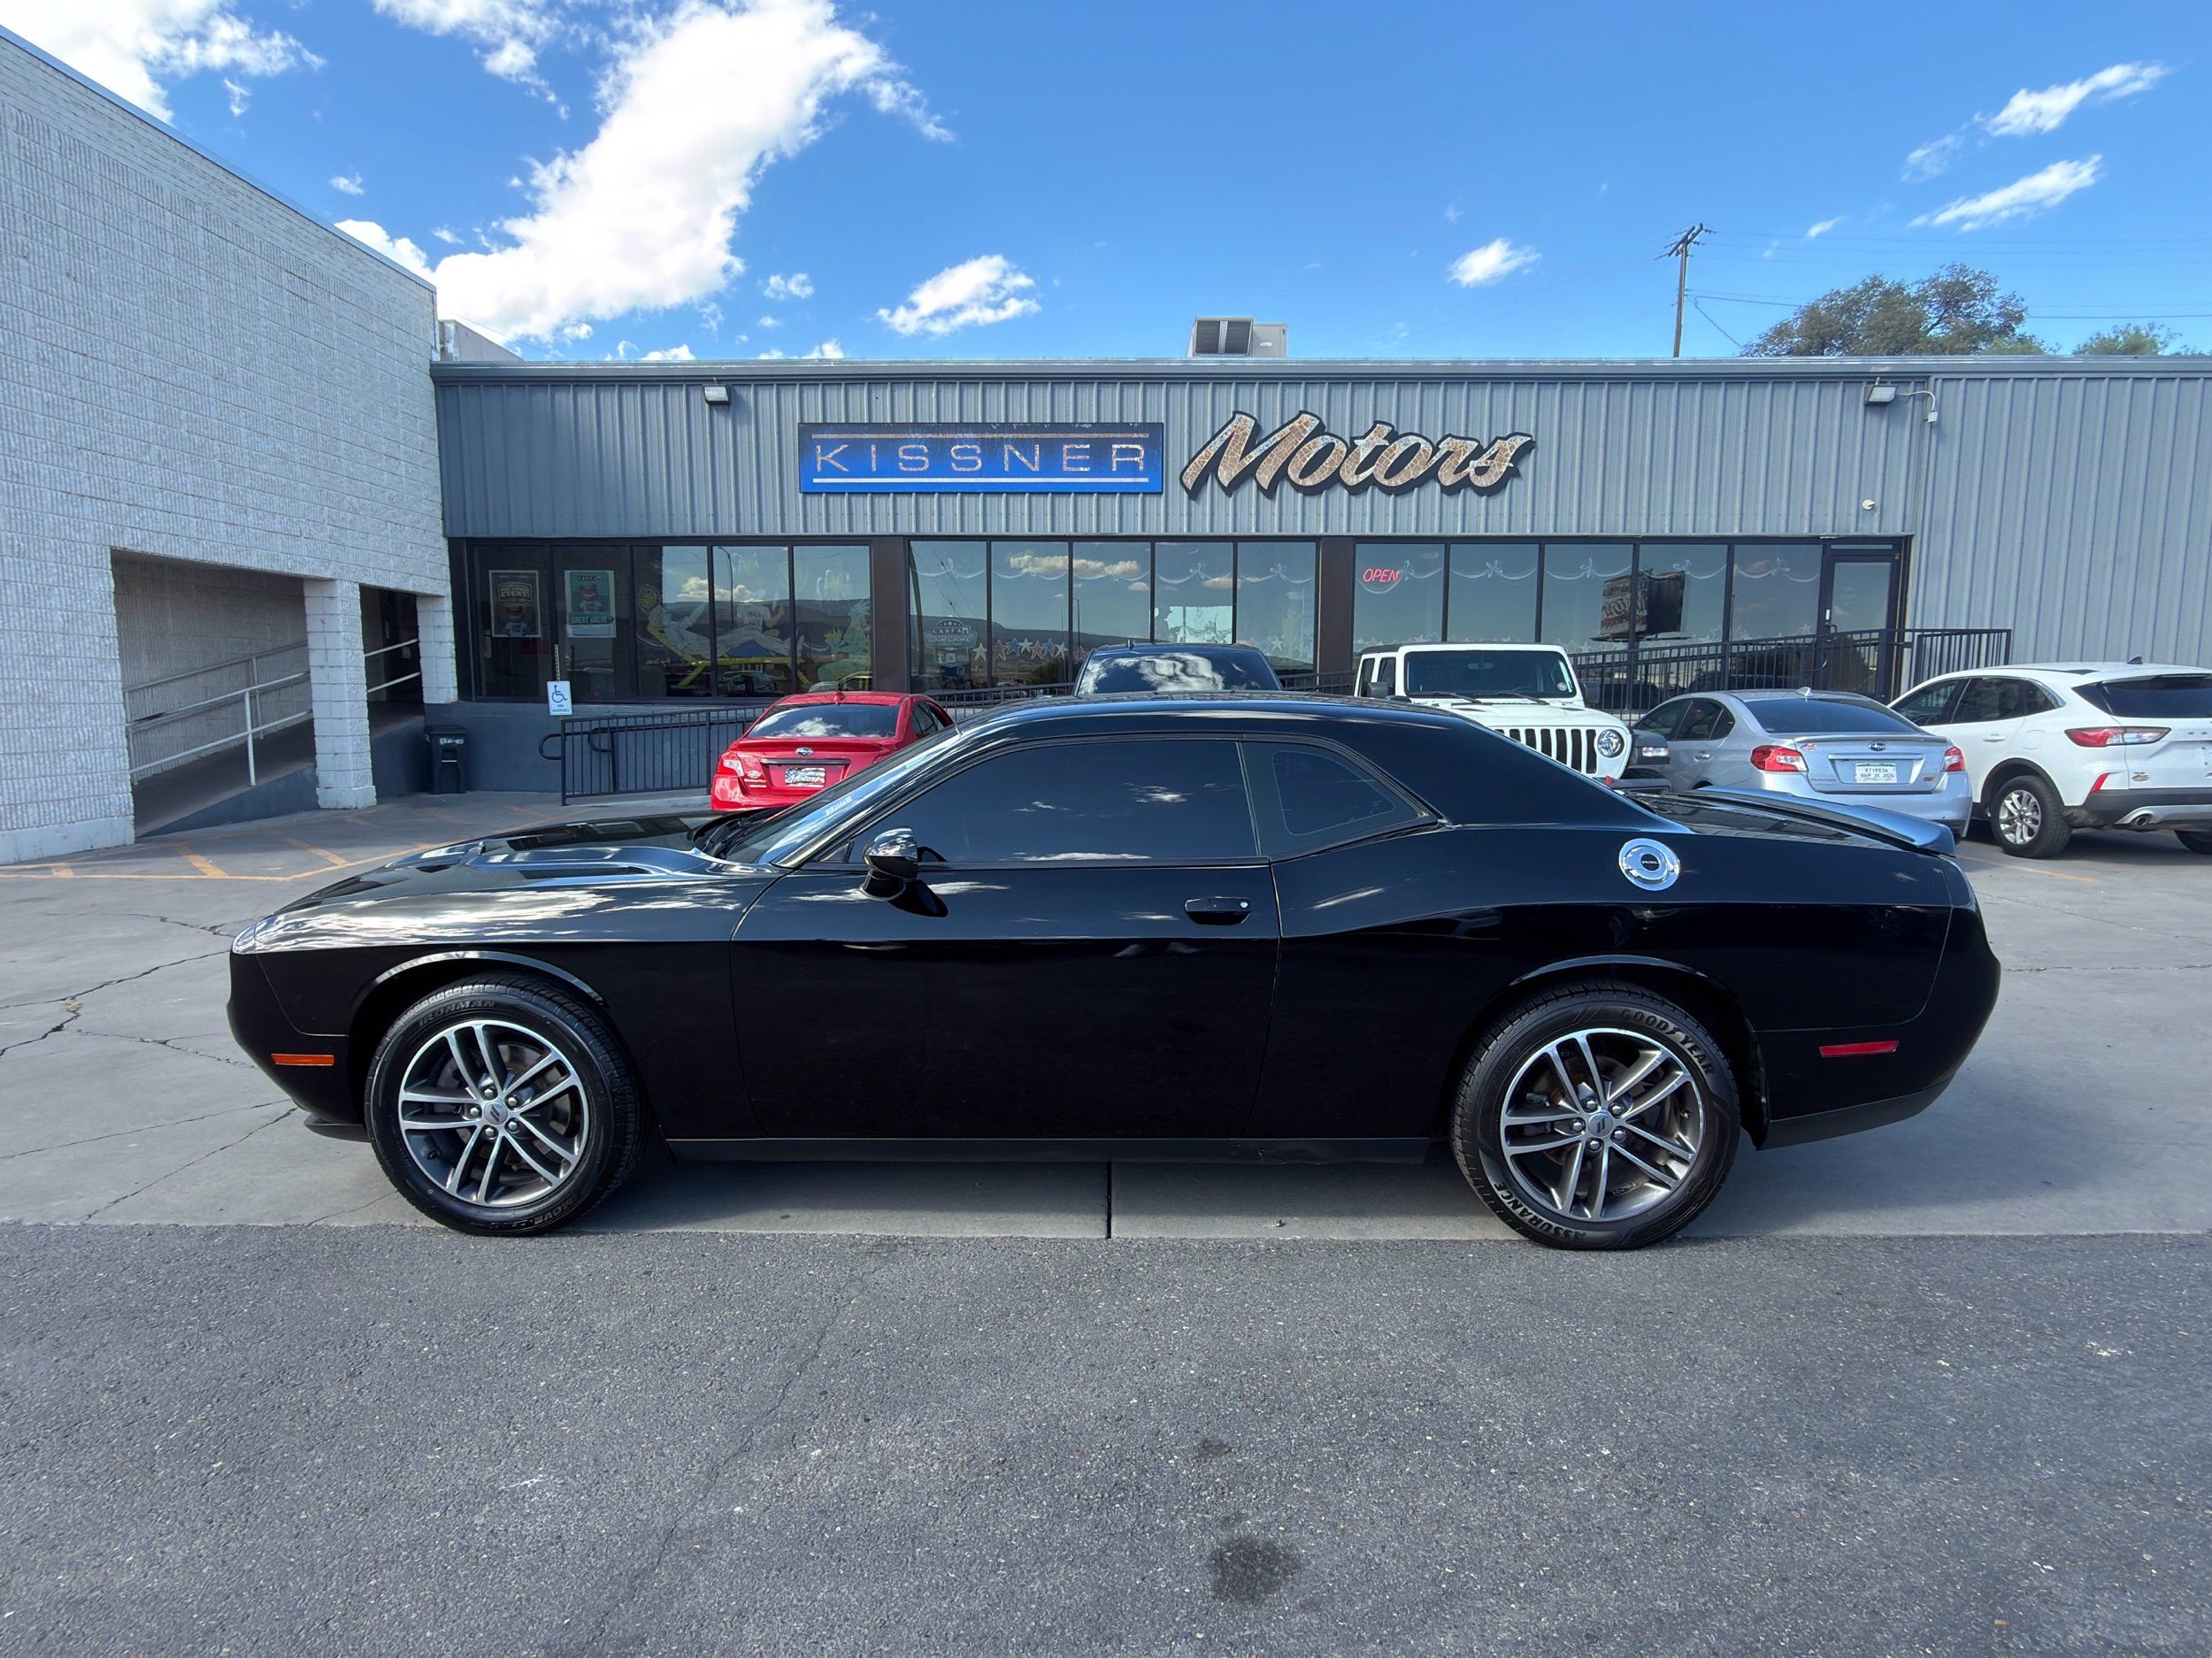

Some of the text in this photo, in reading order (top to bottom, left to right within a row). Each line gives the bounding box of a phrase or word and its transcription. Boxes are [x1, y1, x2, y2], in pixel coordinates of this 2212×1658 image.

[815, 444, 1145, 472] KISSNER
[1179, 411, 1534, 499] Motors
[1363, 568, 1399, 582] OPEN
[1494, 1181, 1586, 1240] ASSURANCE
